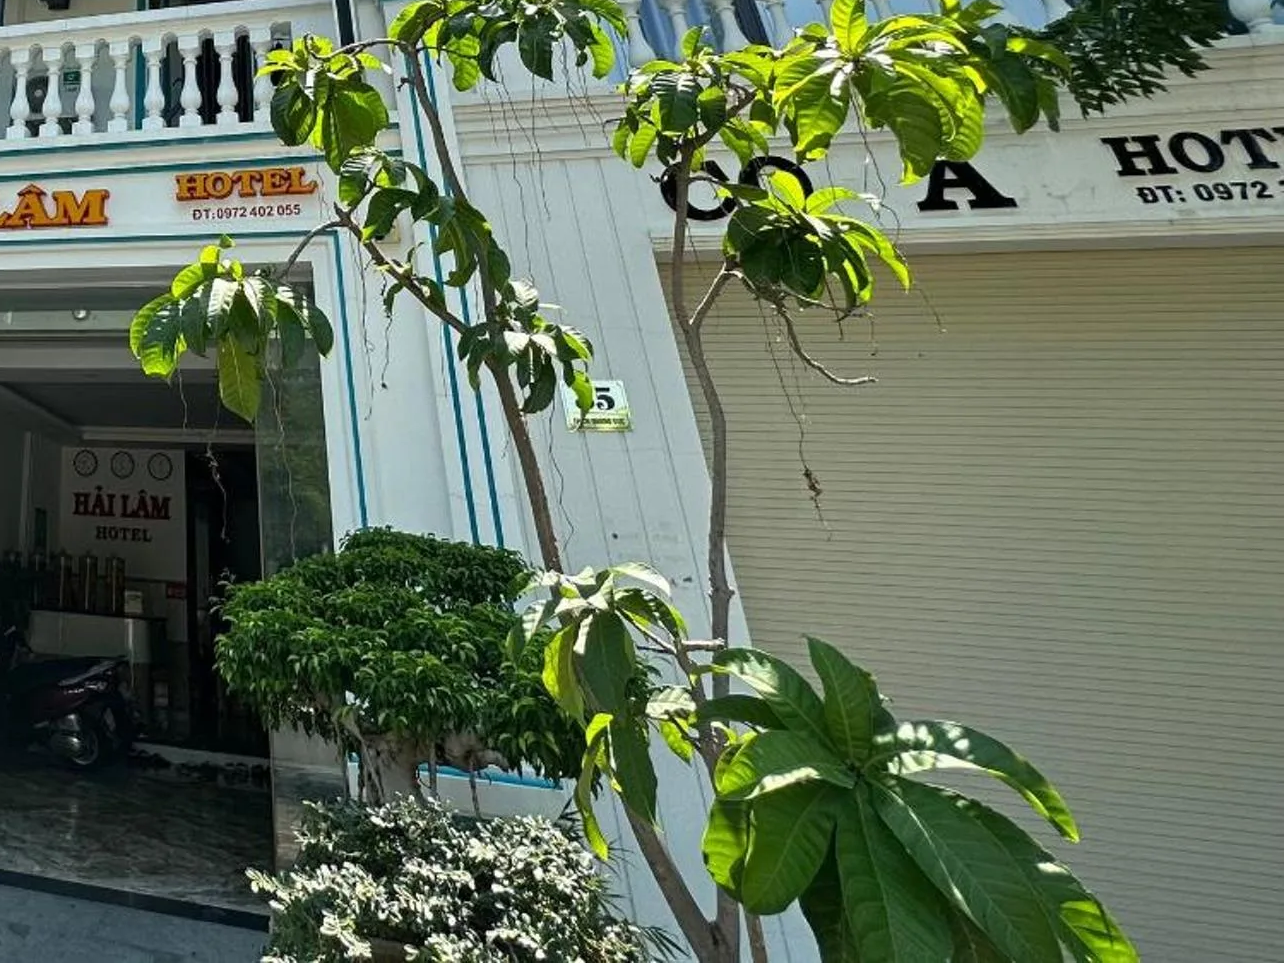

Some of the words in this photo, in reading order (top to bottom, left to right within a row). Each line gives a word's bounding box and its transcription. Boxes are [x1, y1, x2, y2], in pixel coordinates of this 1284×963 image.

[1100, 127, 1284, 177] HOT
[176, 167, 318, 201] HOTEL
[660, 154, 1019, 221] COA
[1192, 181, 1274, 202] 0972
[249, 205, 276, 218] 402
[277, 203, 301, 217] 055
[72, 486, 116, 517] HẢI
[120, 489, 172, 520] LÂM
[95, 525, 153, 542] HOTEL
